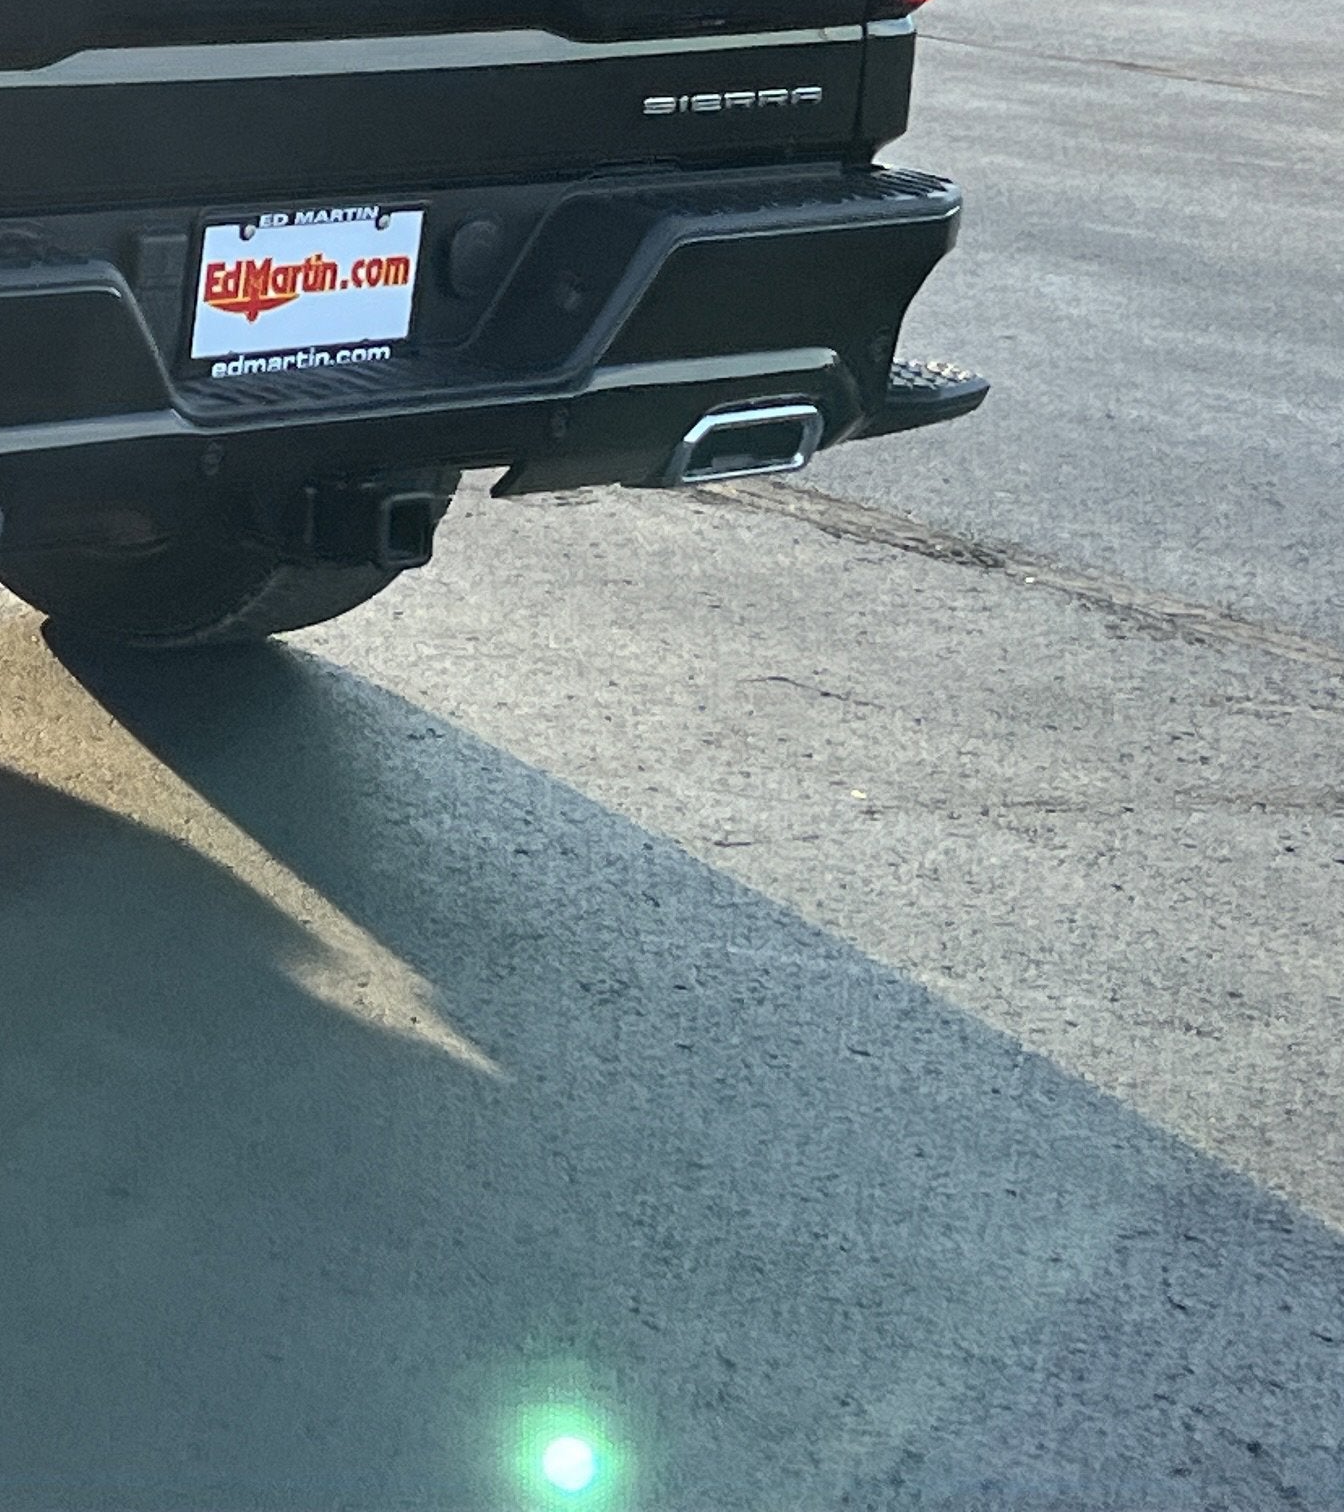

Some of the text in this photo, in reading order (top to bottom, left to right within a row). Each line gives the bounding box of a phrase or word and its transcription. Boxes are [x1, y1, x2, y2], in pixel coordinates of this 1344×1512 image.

[642, 87, 823, 115] SIERRA
[259, 206, 379, 228] ED MARTIN
[212, 344, 391, 378] edmartin.com
